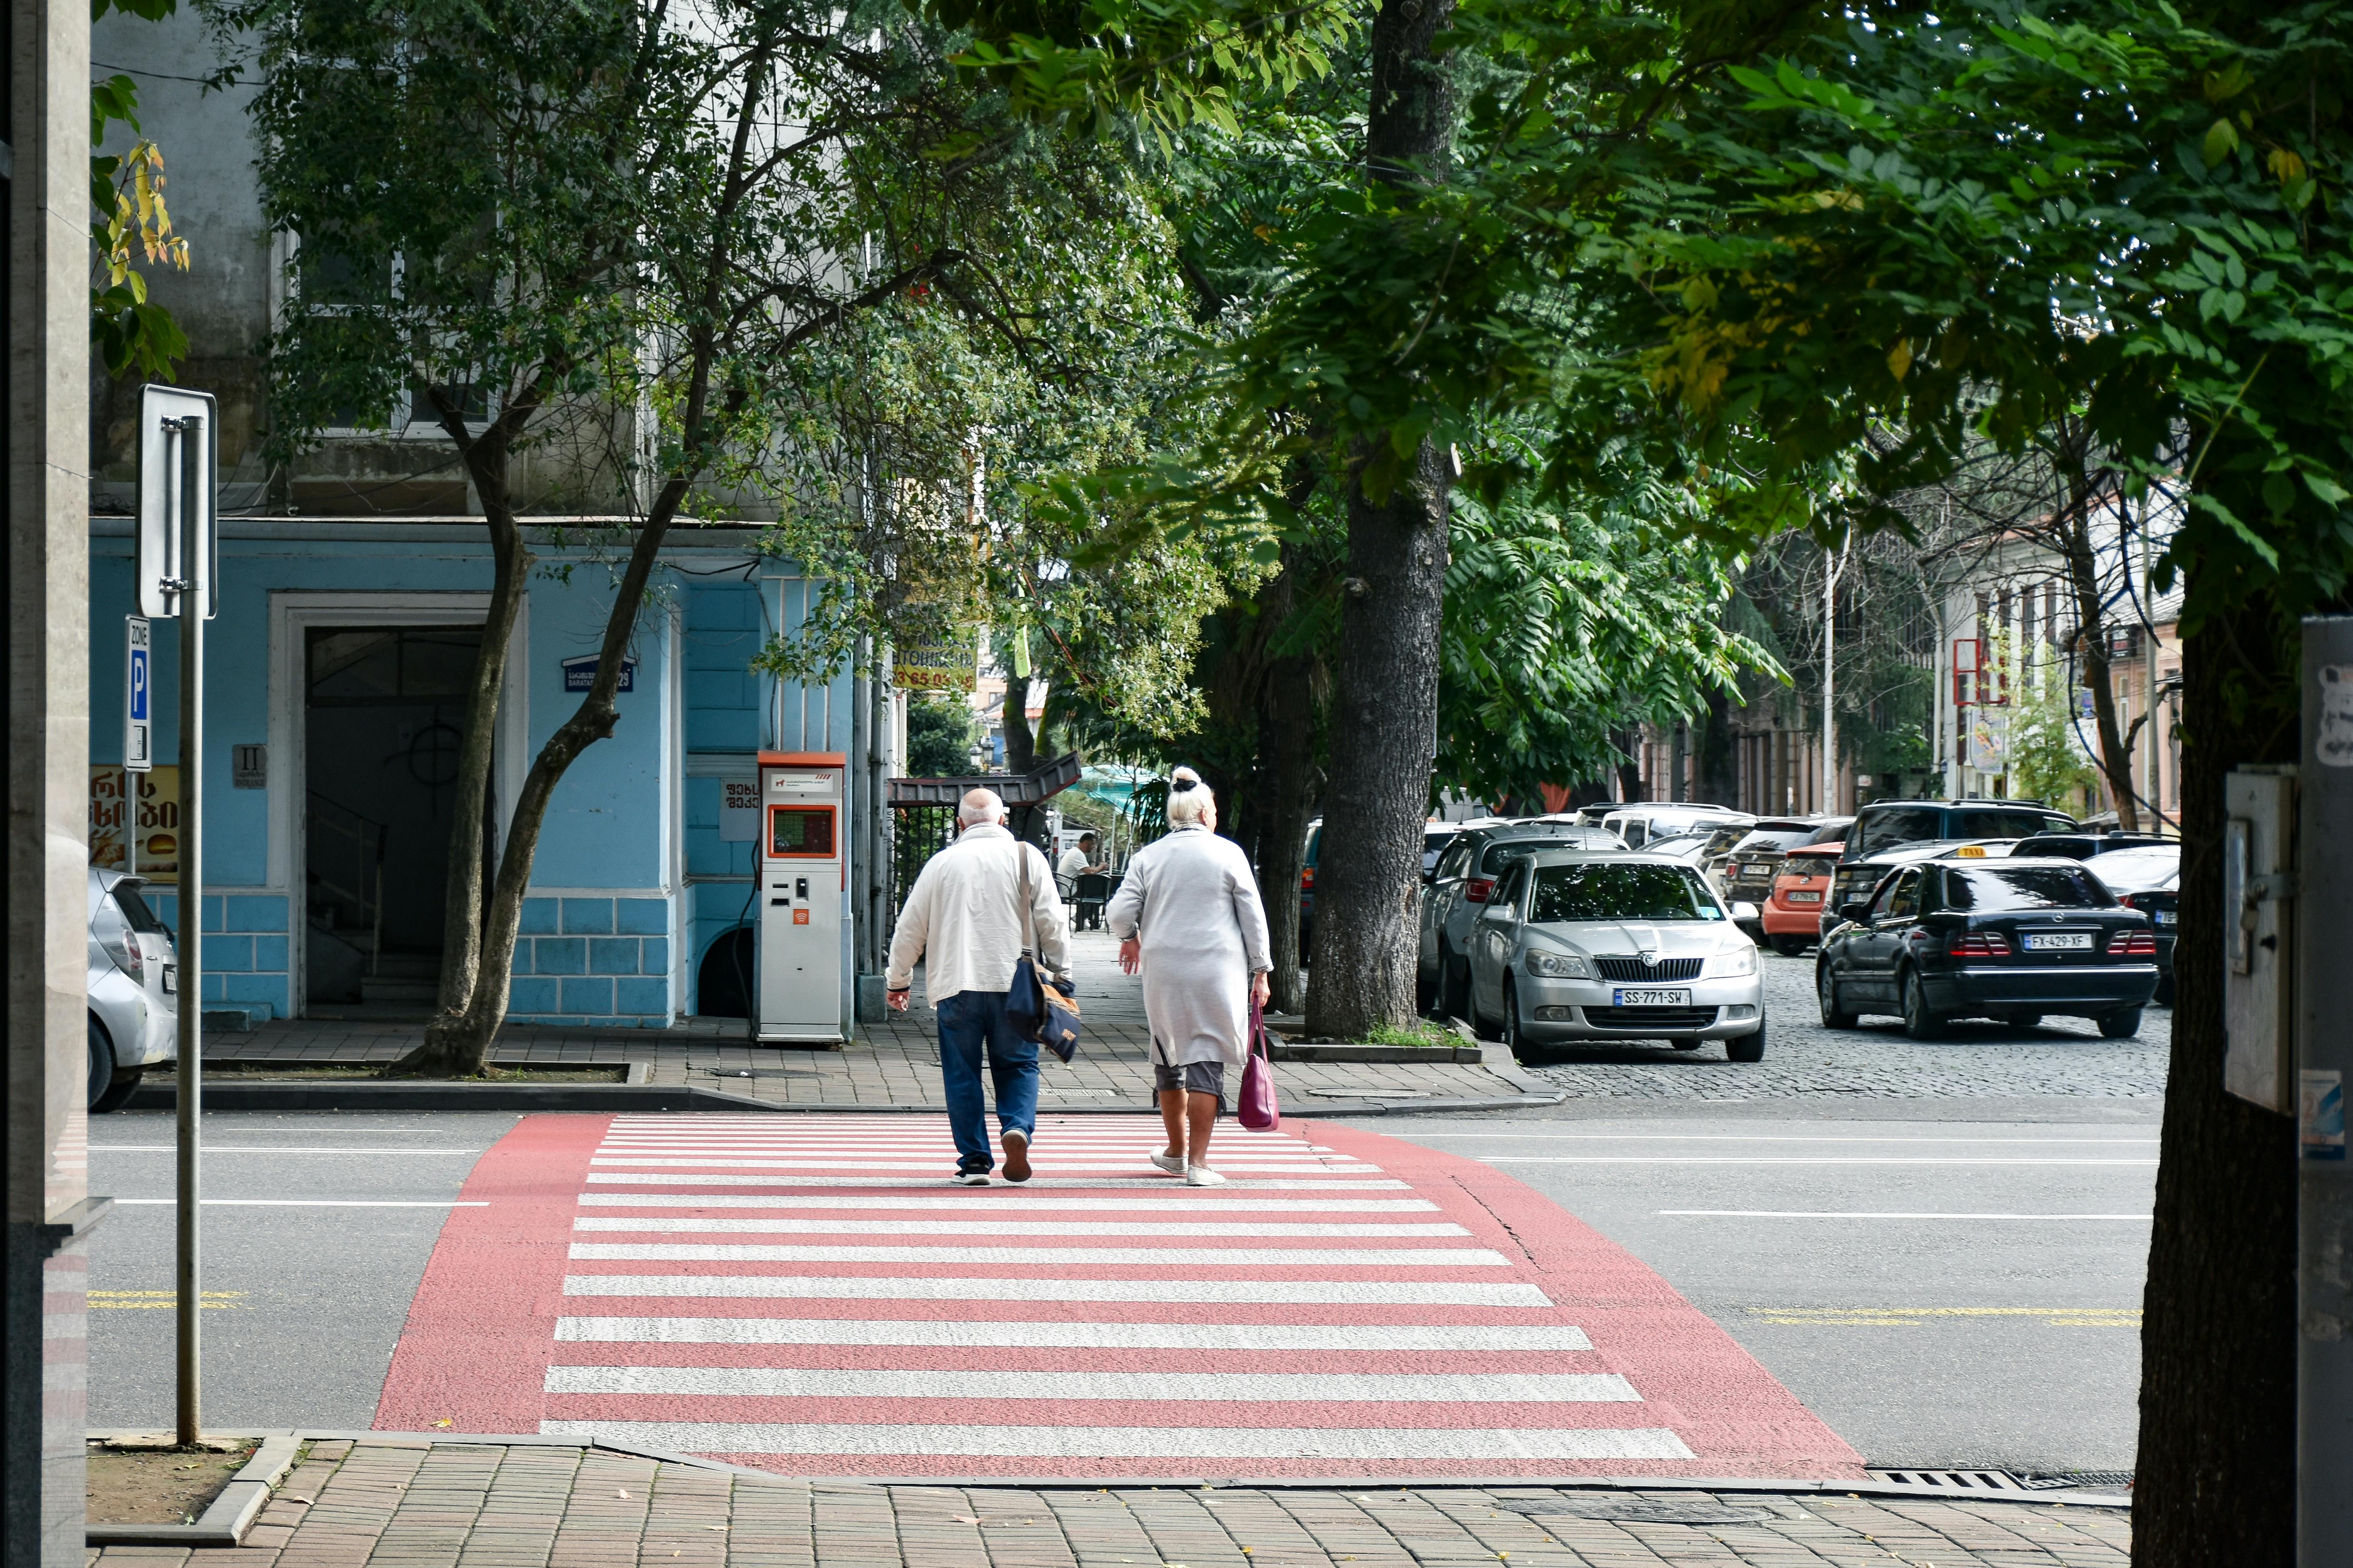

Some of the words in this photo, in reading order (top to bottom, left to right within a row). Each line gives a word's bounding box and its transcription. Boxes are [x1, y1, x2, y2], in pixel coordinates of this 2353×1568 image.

[132, 625, 147, 645] ZONE
[134, 657, 144, 712] P
[619, 672, 629, 686] 29
[911, 672, 929, 685] 65
[2033, 936, 2082, 947] FX-429-XF
[1625, 992, 1682, 1003] SS-771-SW
